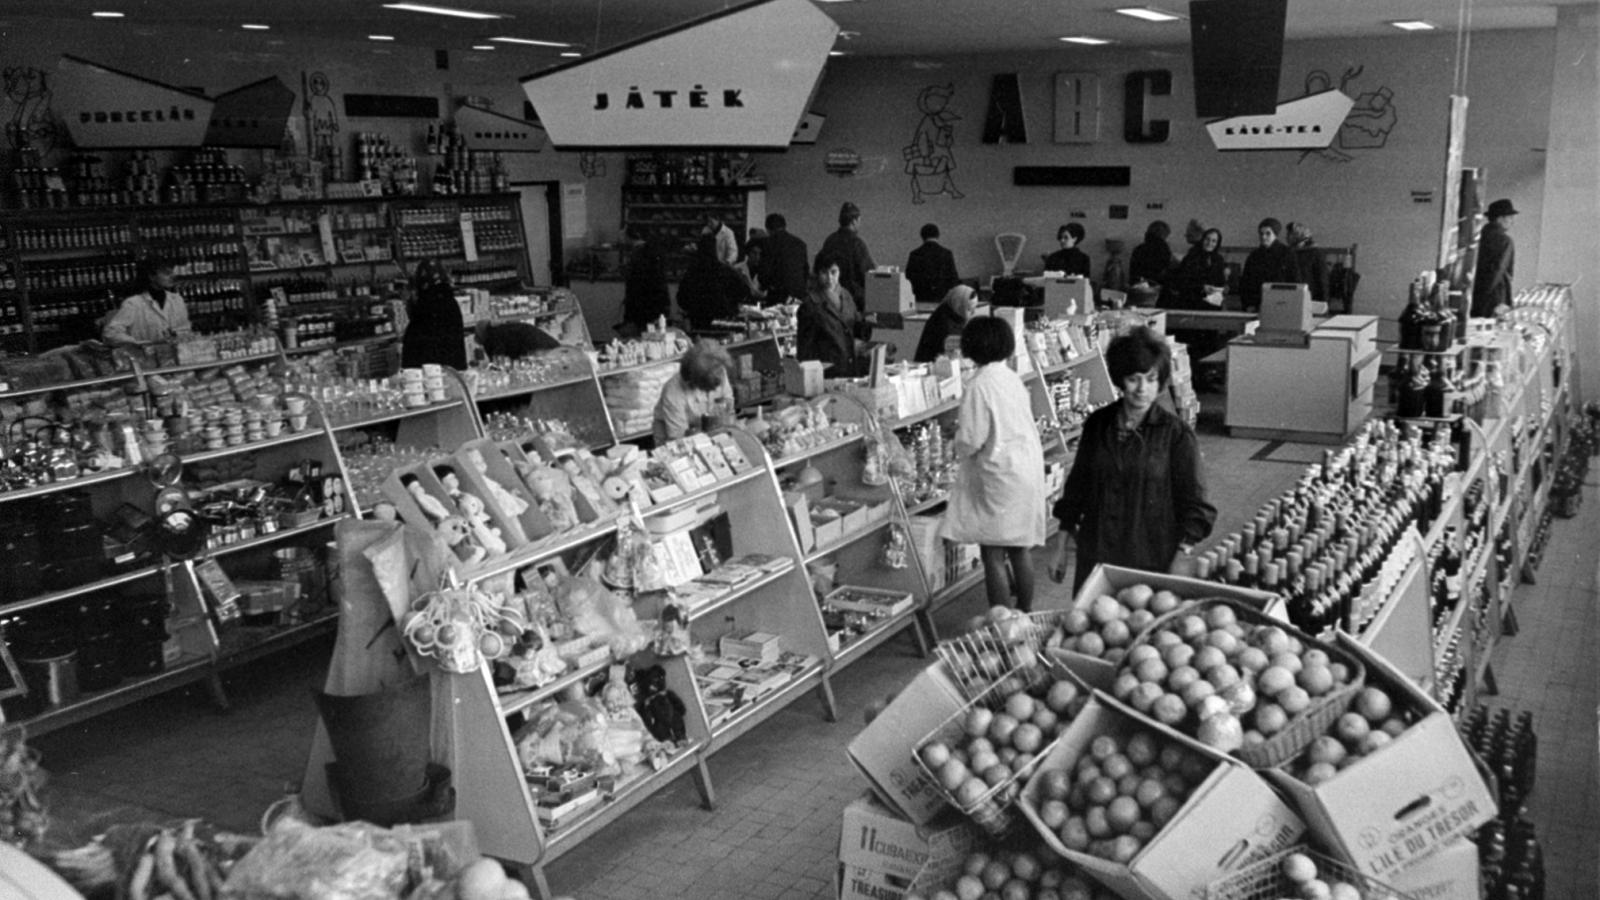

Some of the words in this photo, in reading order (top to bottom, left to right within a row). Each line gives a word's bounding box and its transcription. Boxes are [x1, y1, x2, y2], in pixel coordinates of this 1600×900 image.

[594, 85, 745, 111] JÁTÉK
[982, 69, 1172, 144] ABC
[79, 106, 195, 124] PORCELÁN
[1404, 833, 1427, 855] DU
